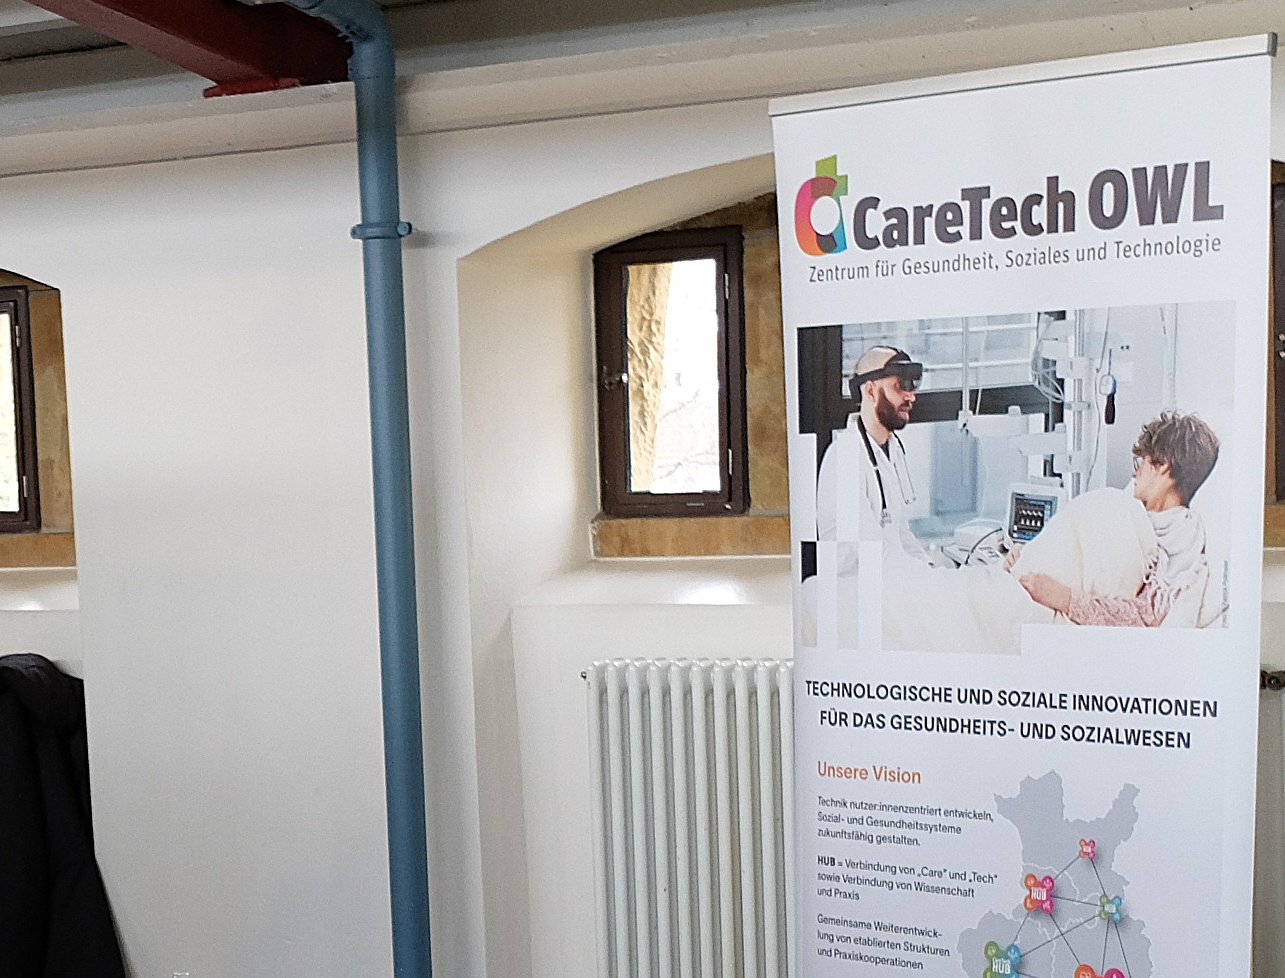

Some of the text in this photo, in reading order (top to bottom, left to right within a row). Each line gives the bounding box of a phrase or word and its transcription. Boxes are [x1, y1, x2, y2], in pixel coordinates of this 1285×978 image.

[853, 160, 1224, 251] CareTech OWL
[809, 234, 1221, 283] Zentrum für Gesundheit, Soziales und Technologie
[805, 680, 1218, 718] TECHNOLOGISCHE UND SOZIALE INNOVATIONEN
[820, 707, 1191, 749] FÜR DAS GESUNDHEITS- UND SOZIALWESEN
[817, 760, 921, 784] Unsere Vision
[818, 796, 848, 810] Technik
[943, 808, 994, 823] entwickeln,
[817, 812, 962, 835] Sozial- und Gesundheitssysteme
[817, 828, 921, 847] zukunftsfähig gestalten.
[817, 855, 836, 868] HUB
[845, 858, 897, 875] Verbindung
[899, 865, 915, 876] von
[949, 870, 967, 881] und
[817, 873, 975, 898] sowie Verbindung von Wissenschaft
[817, 887, 860, 901] und Praxis
[817, 913, 943, 939] Gemeinsame Weiterentwick-
[817, 930, 950, 957] lung von etablierten Strukturen
[817, 948, 923, 970] und Praxiskooperationen
[992, 960, 1011, 974] HUB
